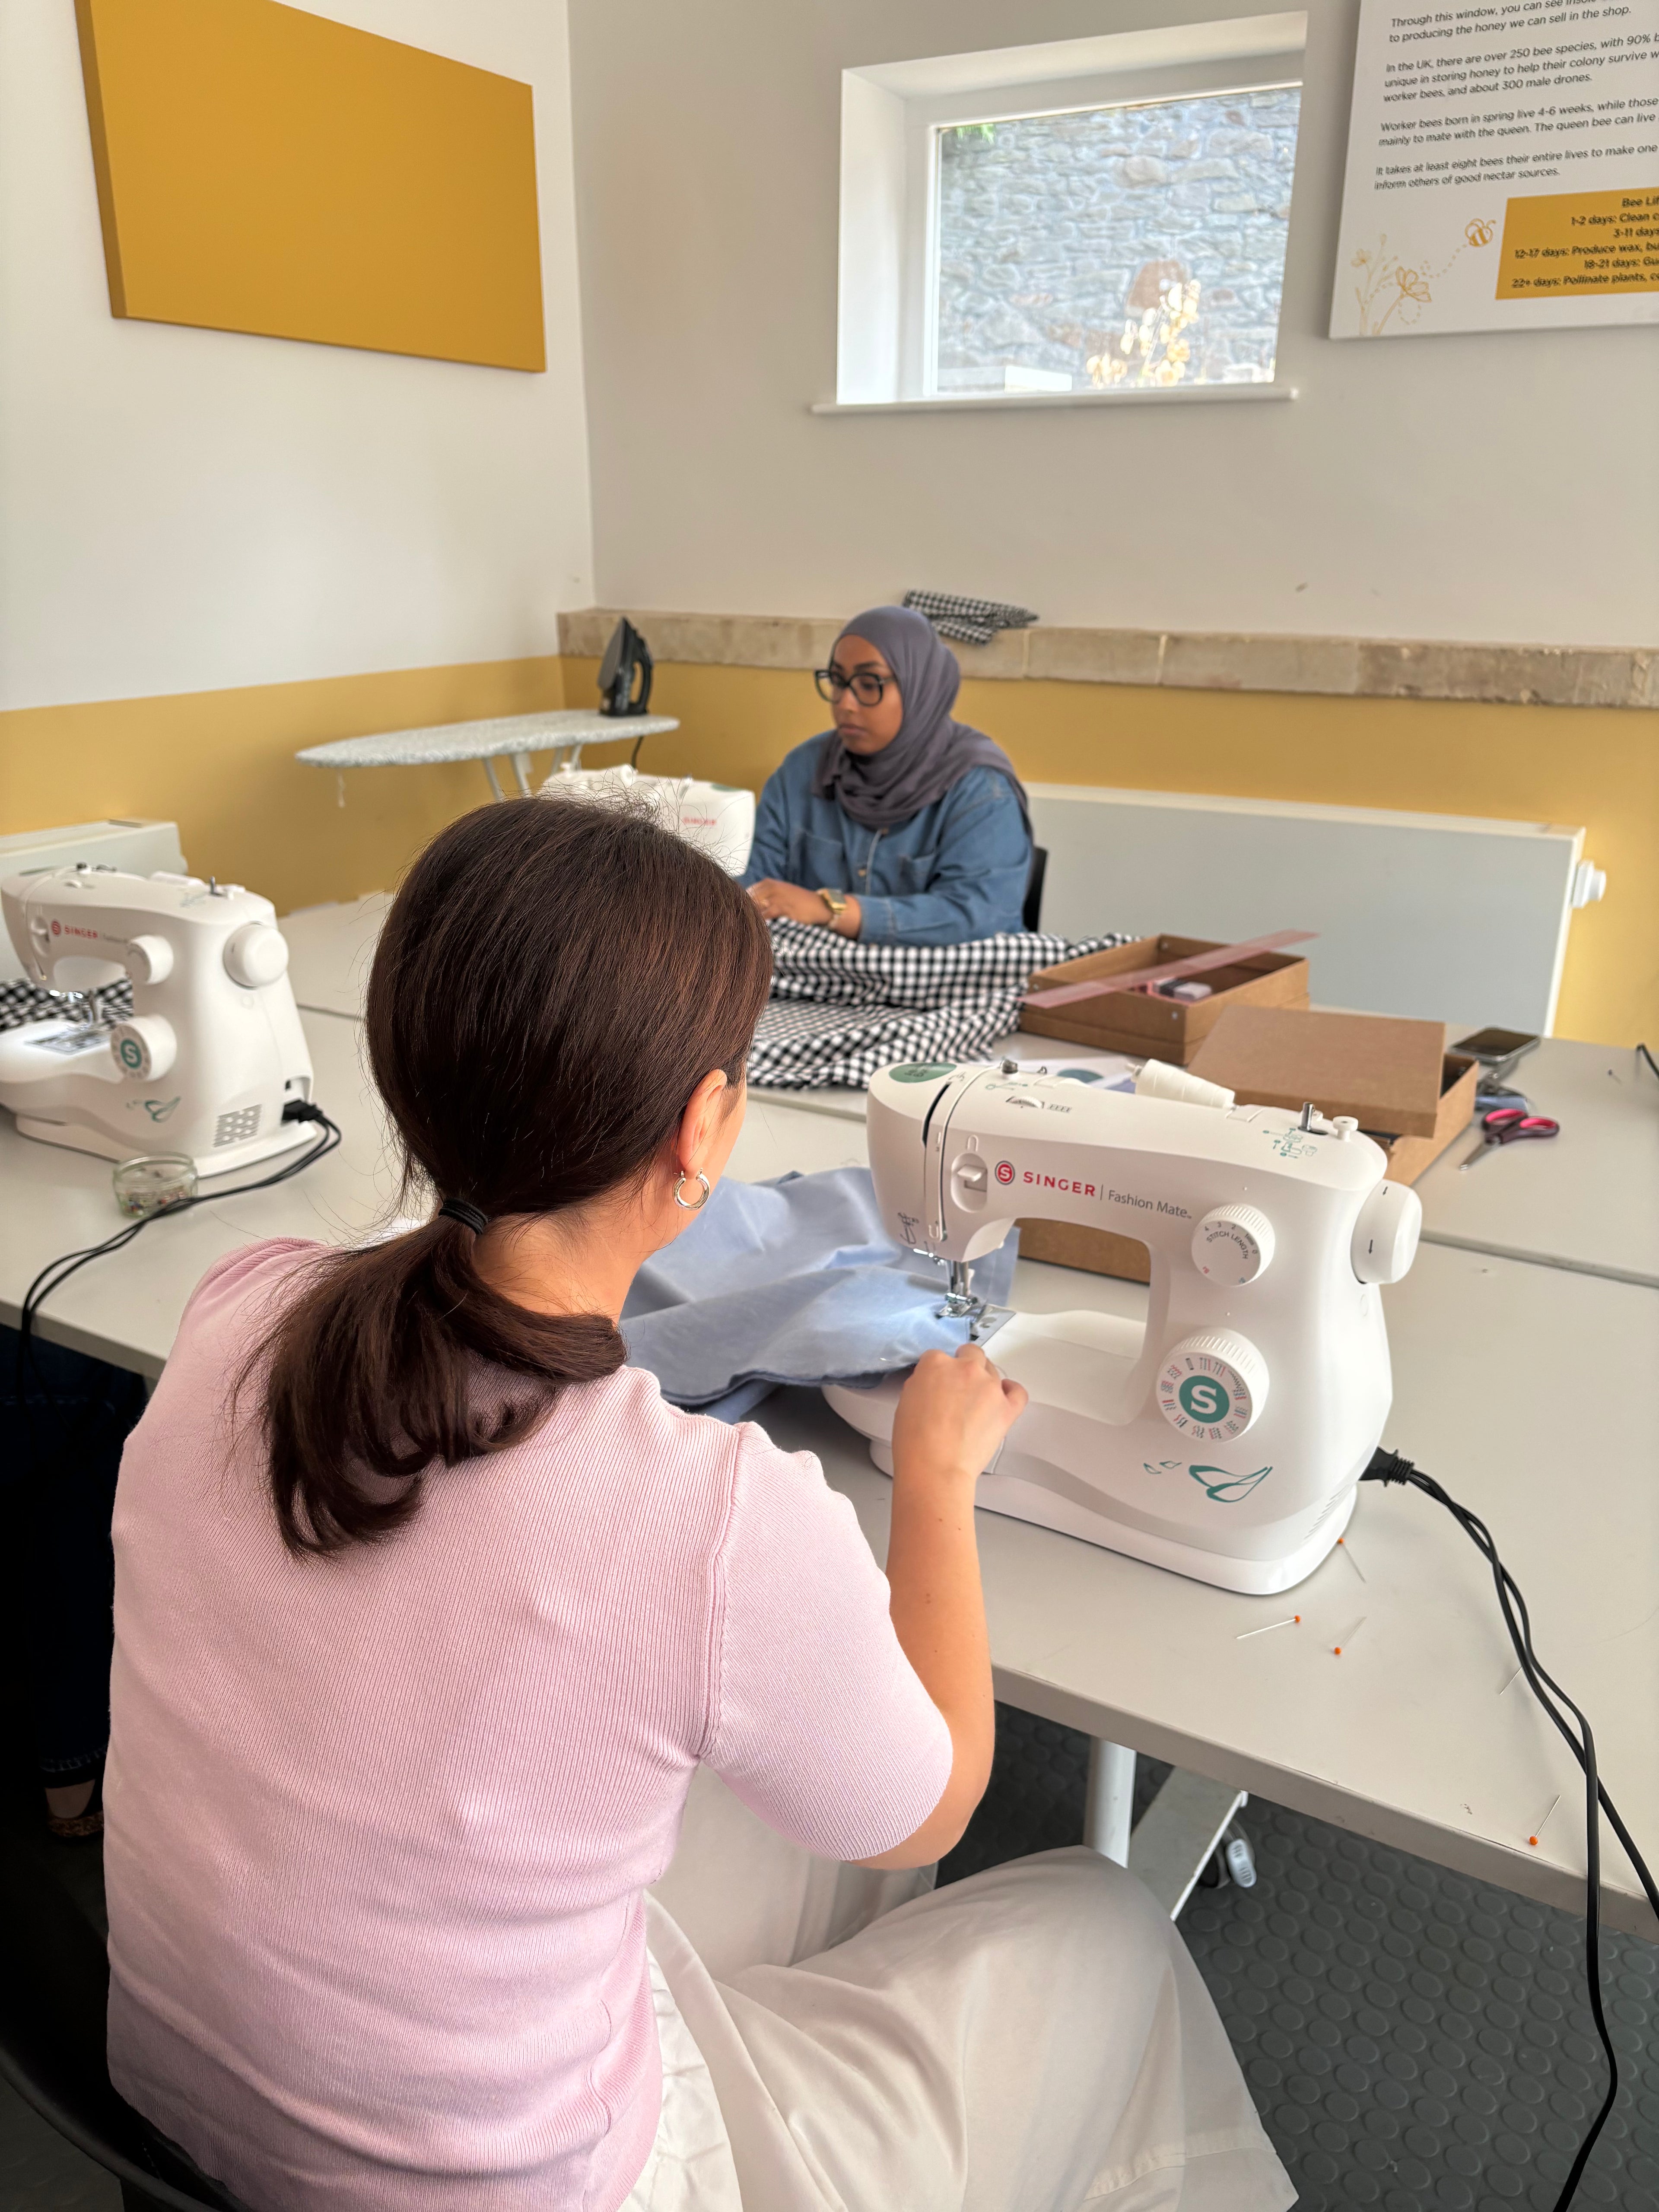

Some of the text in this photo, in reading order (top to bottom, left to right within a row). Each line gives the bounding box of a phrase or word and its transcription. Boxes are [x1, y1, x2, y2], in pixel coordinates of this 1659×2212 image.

[1389, 6, 1631, 43] to producing the honey we can sell in the shop.
[1391, 14, 1432, 27] Through
[1435, 12, 1453, 22] this
[1456, 7, 1497, 20] window,
[1501, 4, 1520, 15] you
[1523, 1, 1541, 12] can
[1545, 0, 1563, 8] see
[1386, 64, 1395, 73] In
[1398, 62, 1414, 71] the
[1416, 59, 1434, 70] UK,
[1436, 56, 1463, 67] there
[1465, 54, 1482, 64] are
[1484, 51, 1507, 62] over
[1510, 47, 1530, 60] 250
[1532, 46, 1552, 56] bee
[1555, 41, 1597, 54] species,
[1601, 37, 1624, 48] with
[1627, 33, 1651, 45] 90%
[1384, 76, 1418, 88] unique
[1420, 75, 1430, 84] in
[1431, 71, 1467, 83] storing
[1469, 67, 1501, 78] honey
[1503, 65, 1515, 75] to
[1516, 63, 1540, 73] help
[1542, 60, 1567, 70] their
[1569, 56, 1605, 67] colony
[1608, 51, 1647, 64] survive
[1383, 91, 1417, 102] worker
[1448, 85, 1468, 96] and
[1469, 82, 1500, 94] about
[1502, 78, 1524, 90] 300
[1526, 77, 1551, 88] male
[1554, 73, 1592, 85] drones.
[1381, 121, 1417, 131] Worker
[1419, 119, 1443, 128] bees
[1445, 116, 1469, 125] born
[1471, 114, 1480, 124] in
[1482, 111, 1515, 123] spring
[1516, 109, 1535, 118] live
[1537, 106, 1556, 116] 4-6
[1597, 100, 1625, 111] while
[1628, 97, 1659, 108] those
[1378, 135, 1411, 146] mainly
[1413, 135, 1424, 143] to
[1426, 132, 1452, 142] mate
[1454, 129, 1476, 140] with
[1478, 127, 1495, 137] the
[1535, 122, 1554, 132] The
[1556, 119, 1589, 130] queen
[1592, 117, 1612, 127] bee
[1615, 115, 1634, 124] can
[1637, 112, 1656, 123] live
[1376, 144, 1658, 176] It takes at least eight bees their entire lives to make one
[1374, 178, 1407, 191] inform
[1408, 177, 1440, 188] others
[1441, 174, 1452, 184] of
[1454, 172, 1481, 185] good
[1483, 171, 1516, 181] nectar
[1622, 197, 1643, 208] Bee
[1571, 216, 1586, 226] 1-2
[1588, 215, 1617, 226] days:
[1619, 212, 1650, 223] Clean
[1613, 227, 1633, 238] 3-11
[1571, 245, 1617, 255] Produce
[1563, 274, 1610, 286] Pollinate
[1023, 1171, 1096, 1197] SINGER
[1108, 1189, 1153, 1210] Fashion
[1206, 1231, 1249, 1259] STITCH LENGTH
[1191, 1385, 1217, 1414] S
